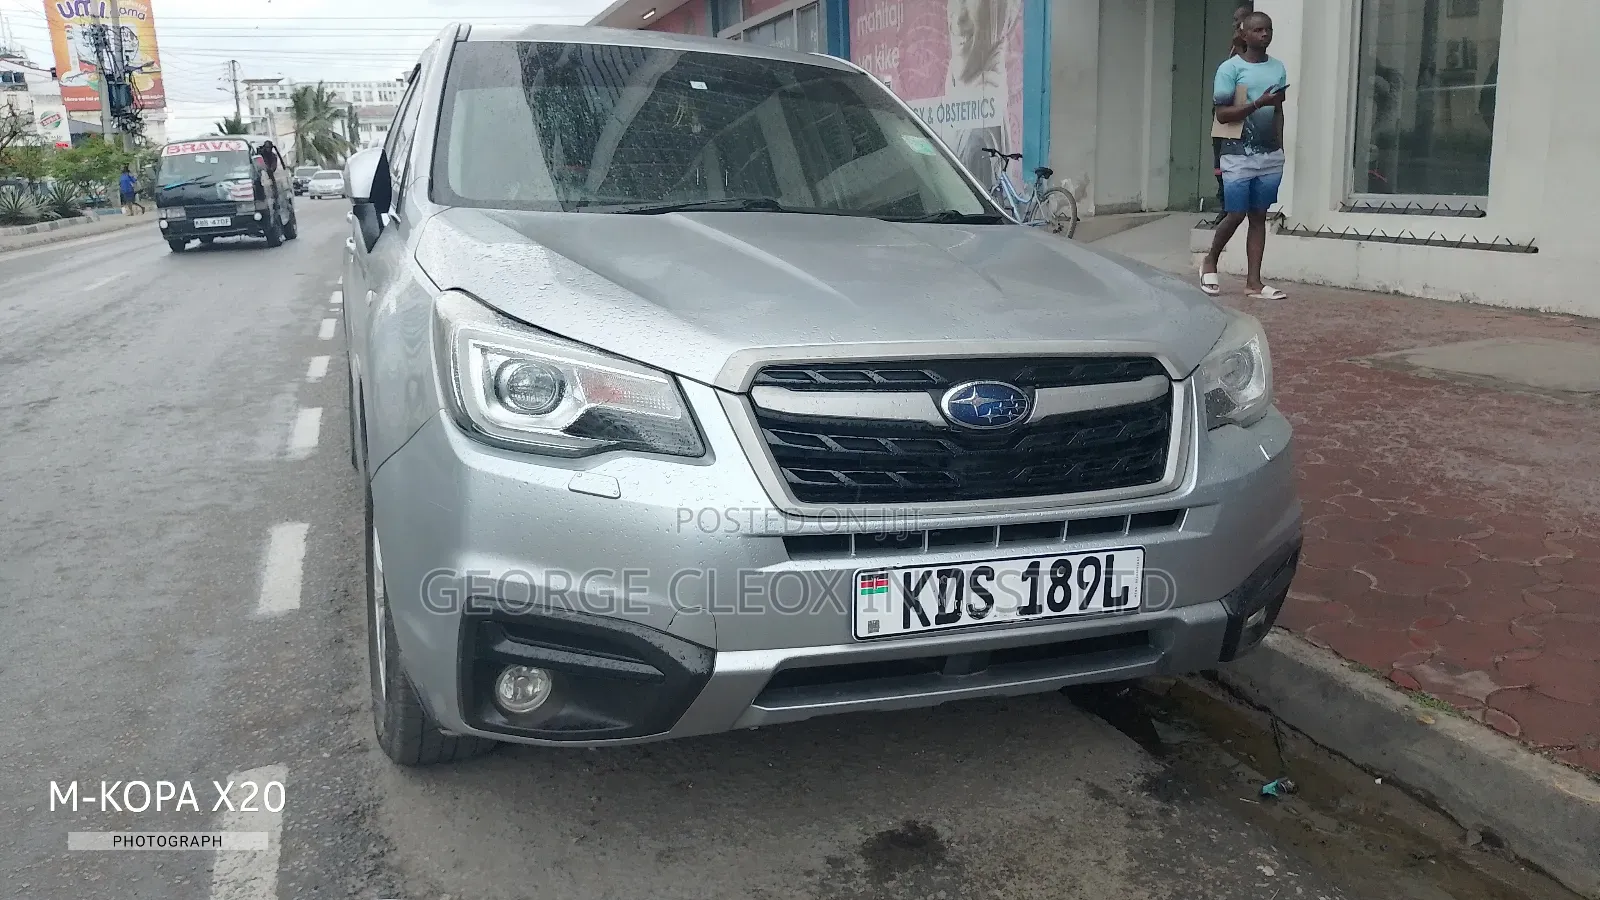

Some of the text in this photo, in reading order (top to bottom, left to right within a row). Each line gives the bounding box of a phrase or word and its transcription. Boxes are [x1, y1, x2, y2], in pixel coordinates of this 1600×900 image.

[857, 1, 904, 36] mahitaji
[875, 44, 899, 73] kike
[927, 106, 934, 124] &
[936, 97, 996, 123] OBSTETRICS
[166, 141, 241, 155] BRAVO
[903, 566, 995, 629] KDS
[1016, 554, 1129, 616] 189L
